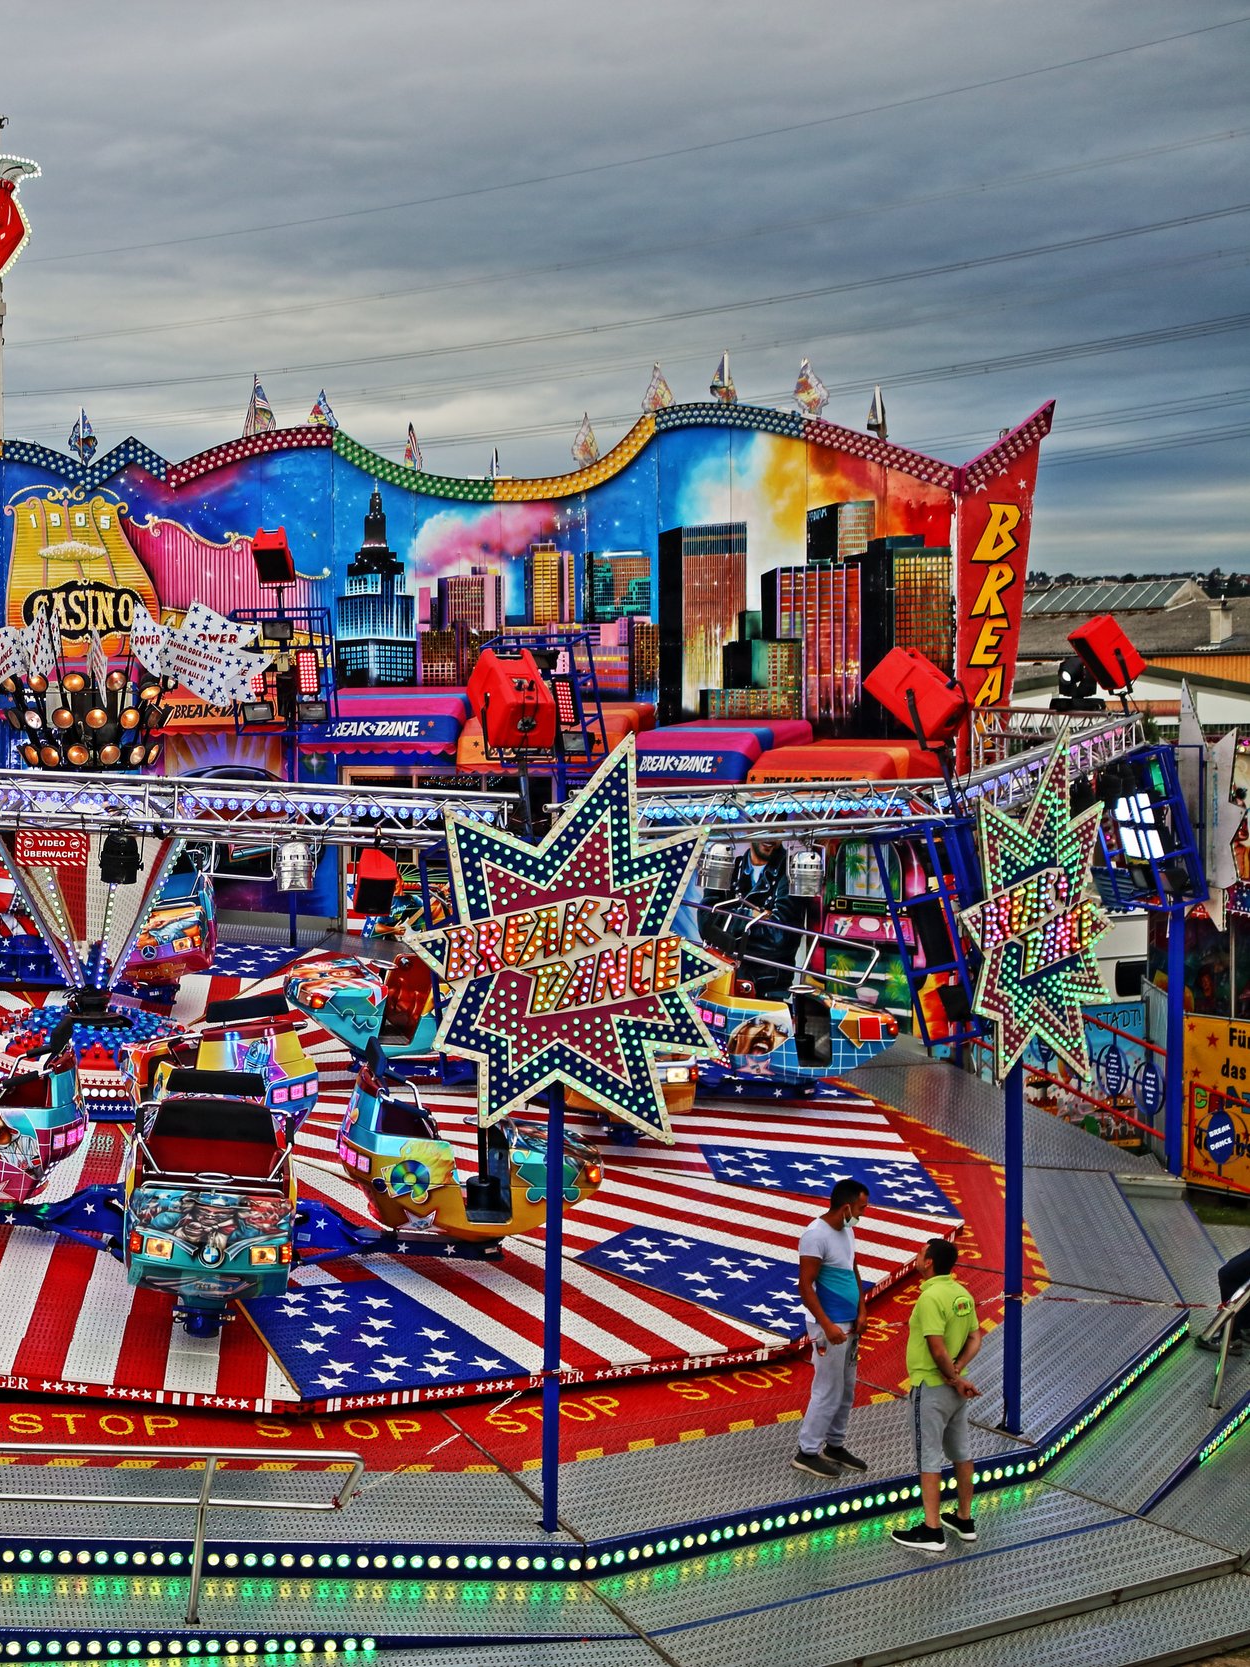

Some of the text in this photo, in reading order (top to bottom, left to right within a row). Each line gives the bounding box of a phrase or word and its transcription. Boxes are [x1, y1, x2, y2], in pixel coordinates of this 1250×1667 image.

[32, 590, 134, 631] CASINO
[32, 616, 46, 666] POWER
[134, 634, 160, 646] POWER
[198, 633, 238, 644] OWER
[188, 647, 202, 657] ODER
[175, 654, 208, 671] KRIEGEN WIR
[173, 665, 187, 675] EUCH
[188, 671, 200, 680] ALLE
[174, 703, 214, 719] BREAK
[326, 720, 419, 737] REAK DANCE
[639, 756, 713, 773] BREAK DANCE
[38, 839, 65, 847] VIDEO
[23, 849, 80, 858] ÜBERWACHT
[980, 872, 1056, 951] BREAK
[446, 900, 600, 981] BREAK
[1018, 899, 1092, 975] DANCE
[519, 936, 682, 1014] DANCE
[1221, 1057, 1246, 1080] das
[1209, 1124, 1230, 1138] BREAK
[1210, 1137, 1232, 1150] DANCE
[529, 1369, 584, 1388] DAGER
[667, 1364, 794, 1401] STOP
[486, 1395, 620, 1434] STOP
[8, 1413, 179, 1437] STOP
[255, 1417, 422, 1441] STOP
